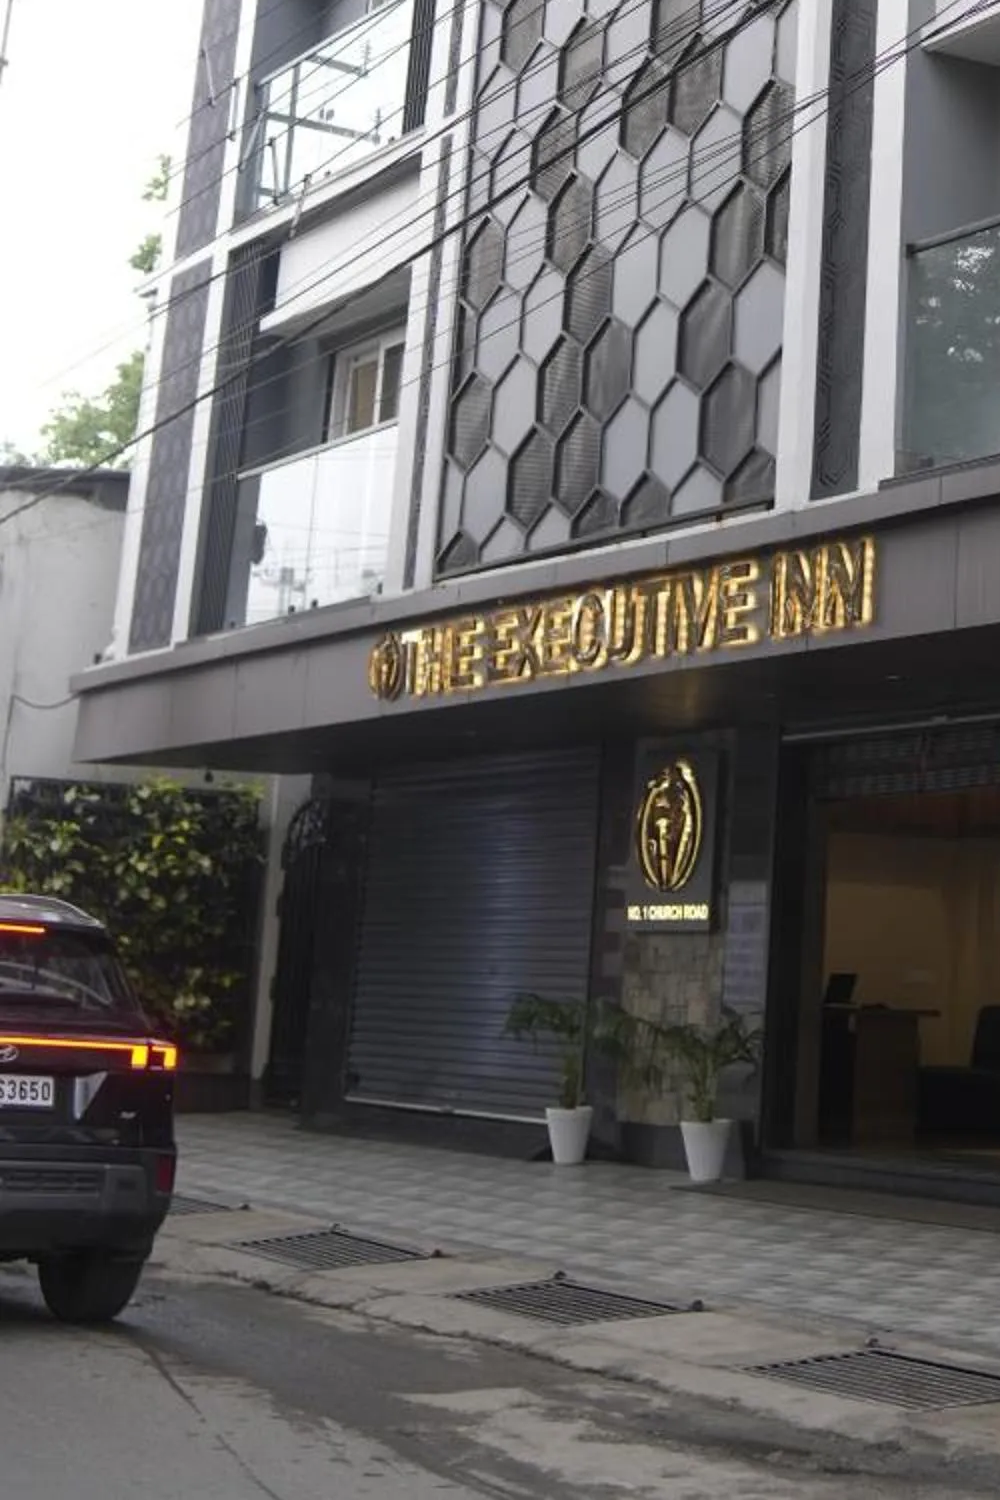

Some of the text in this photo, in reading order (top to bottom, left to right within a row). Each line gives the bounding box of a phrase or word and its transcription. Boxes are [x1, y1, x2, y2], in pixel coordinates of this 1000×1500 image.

[401, 536, 877, 696] THE EXECUTIVE INN
[683, 903, 709, 920] ROAD
